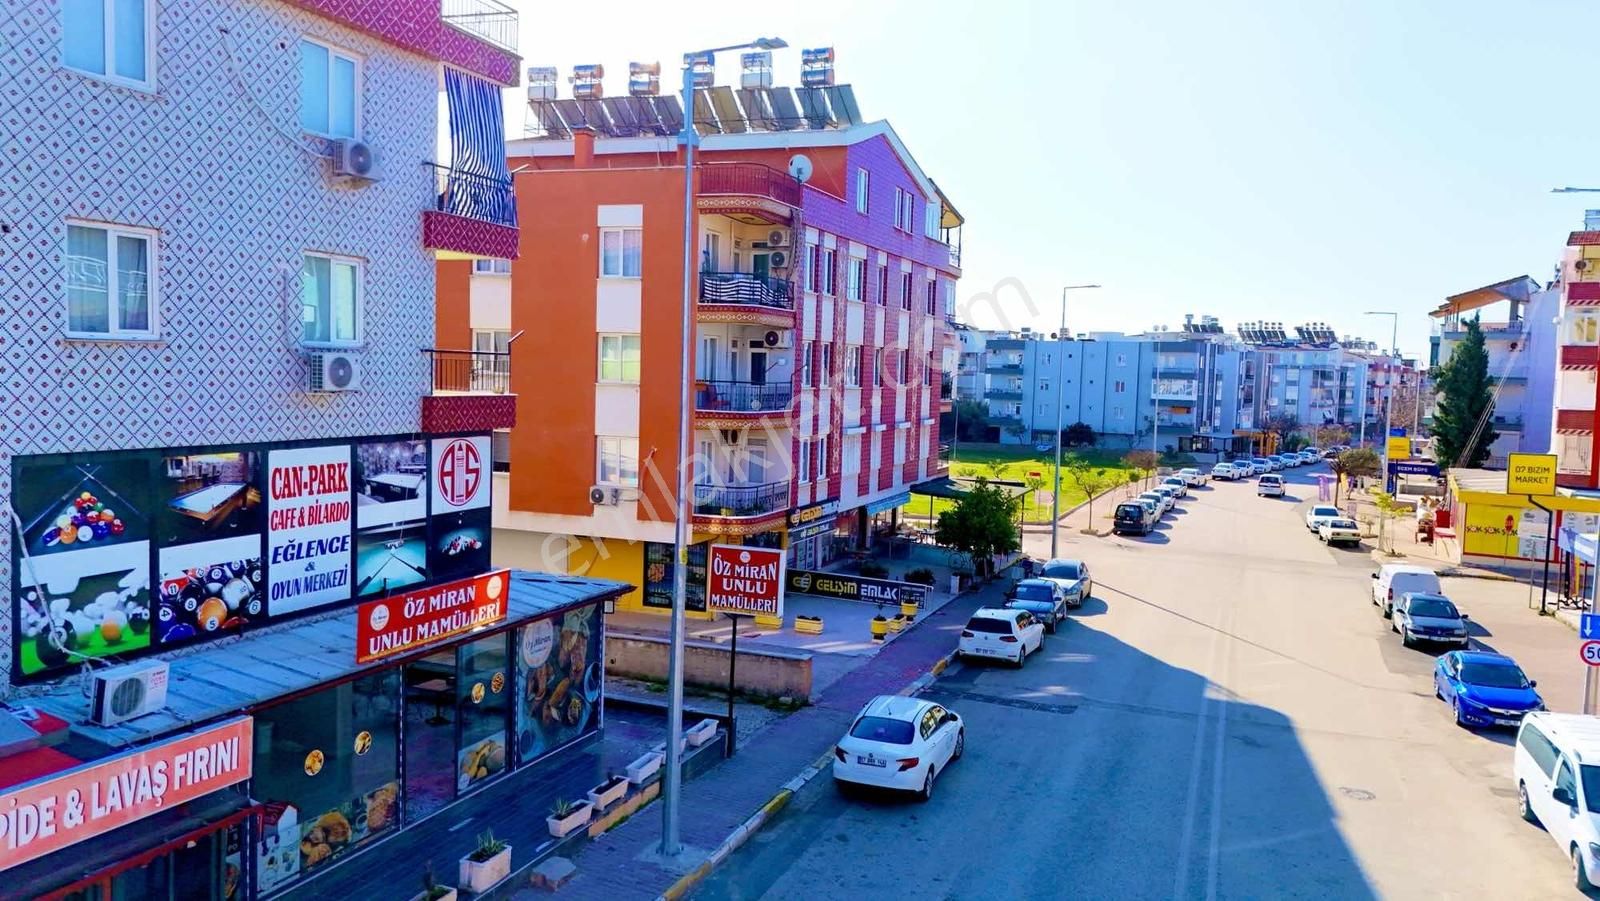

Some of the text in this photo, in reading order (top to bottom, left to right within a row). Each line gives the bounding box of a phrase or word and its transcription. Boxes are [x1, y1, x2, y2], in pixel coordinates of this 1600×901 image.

[271, 462, 349, 500] CAN-PARK
[271, 499, 350, 531] CAFE & BİLARDO
[271, 534, 350, 565] EĞLENCE
[271, 563, 348, 601] OYUN MERKEZİ
[713, 552, 777, 581] ÖZ MİRAN
[722, 577, 767, 594] UNLU
[861, 583, 898, 600] EMLAK
[403, 596, 425, 619] ÖZ
[429, 585, 476, 612] MİRAN
[711, 593, 776, 612] MAMÜLLERİ
[369, 626, 413, 655] UNLU
[416, 599, 501, 640] MAMÜLLERİ
[63, 788, 85, 829] &
[91, 760, 169, 820] LAVAŞ
[173, 736, 240, 791] FIRINI
